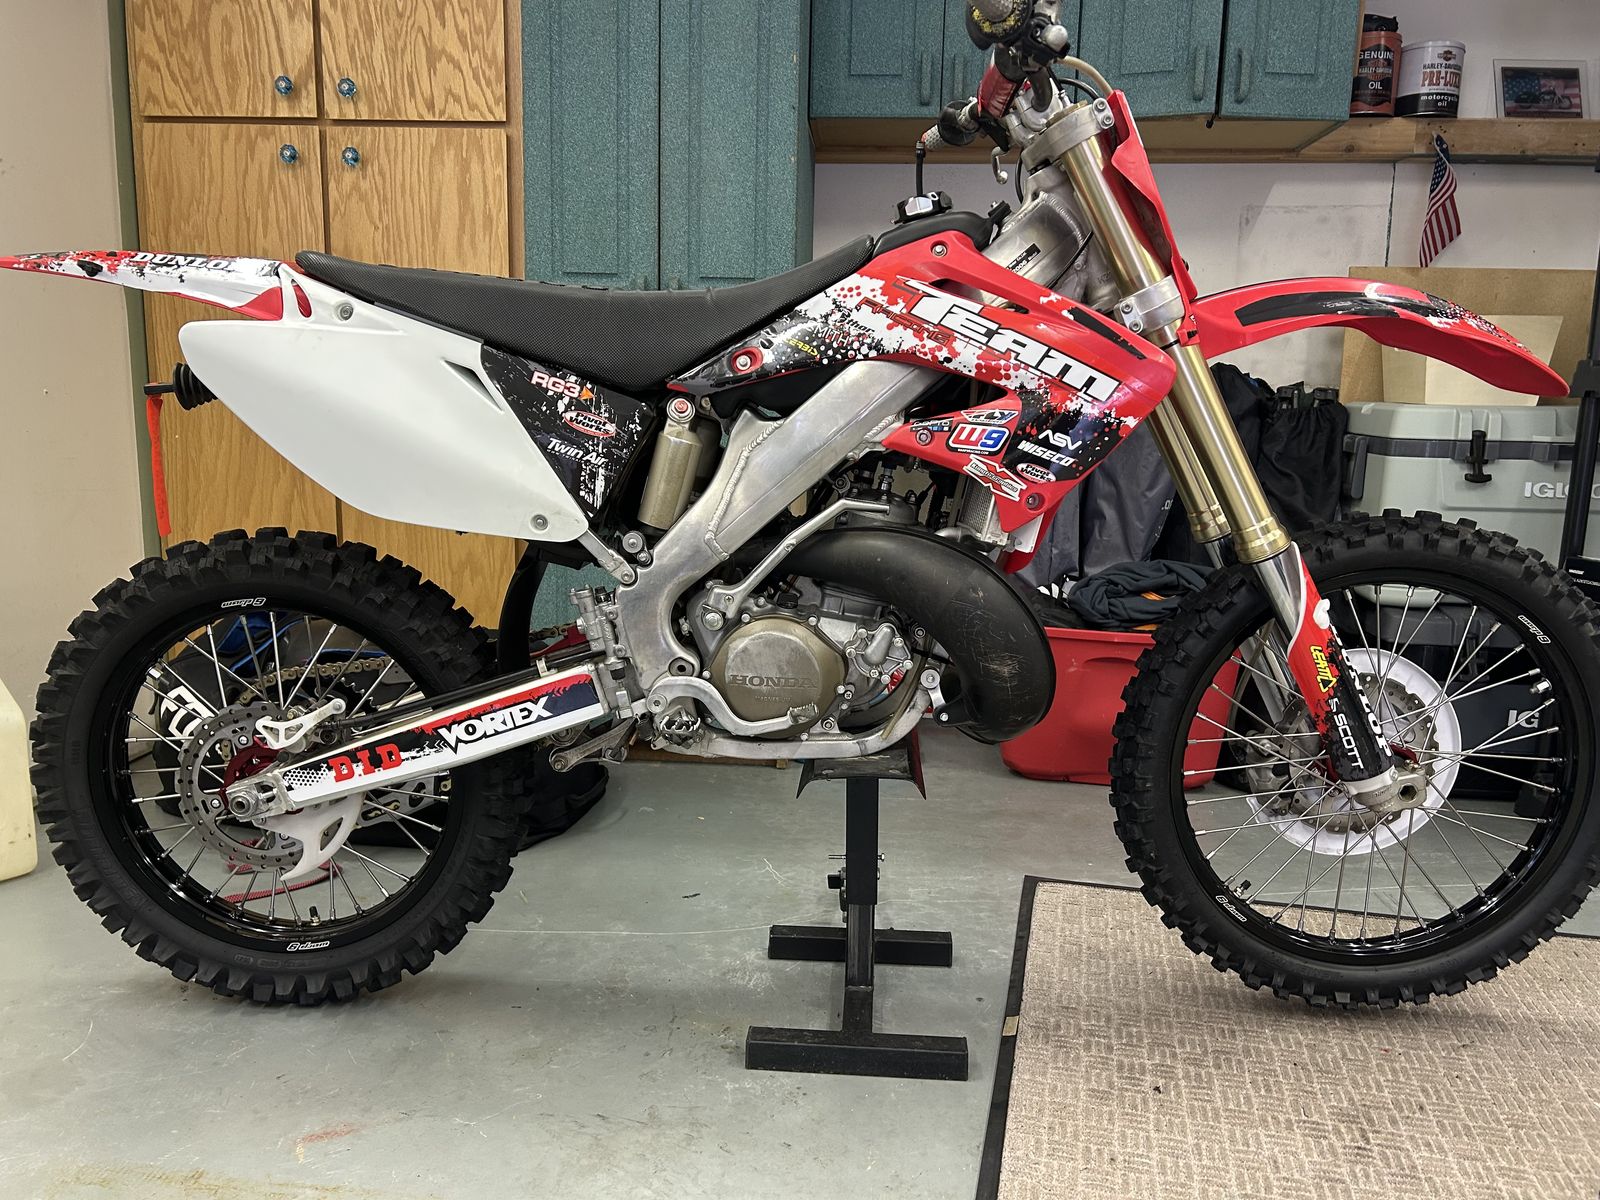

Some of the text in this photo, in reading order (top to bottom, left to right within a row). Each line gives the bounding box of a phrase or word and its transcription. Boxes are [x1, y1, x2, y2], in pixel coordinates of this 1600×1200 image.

[1359, 50, 1394, 60] GENUIN
[1368, 81, 1383, 90] OIL
[1421, 70, 1461, 88] PRE-LUX
[895, 275, 1121, 403] TEAM
[530, 370, 580, 399] RG3
[547, 437, 584, 459] Twin
[582, 451, 609, 466] Air
[1017, 440, 1076, 467] WISECO
[728, 674, 818, 689] HONDA
[437, 695, 553, 754] VORTEX
[1333, 713, 1365, 769] SCOTT
